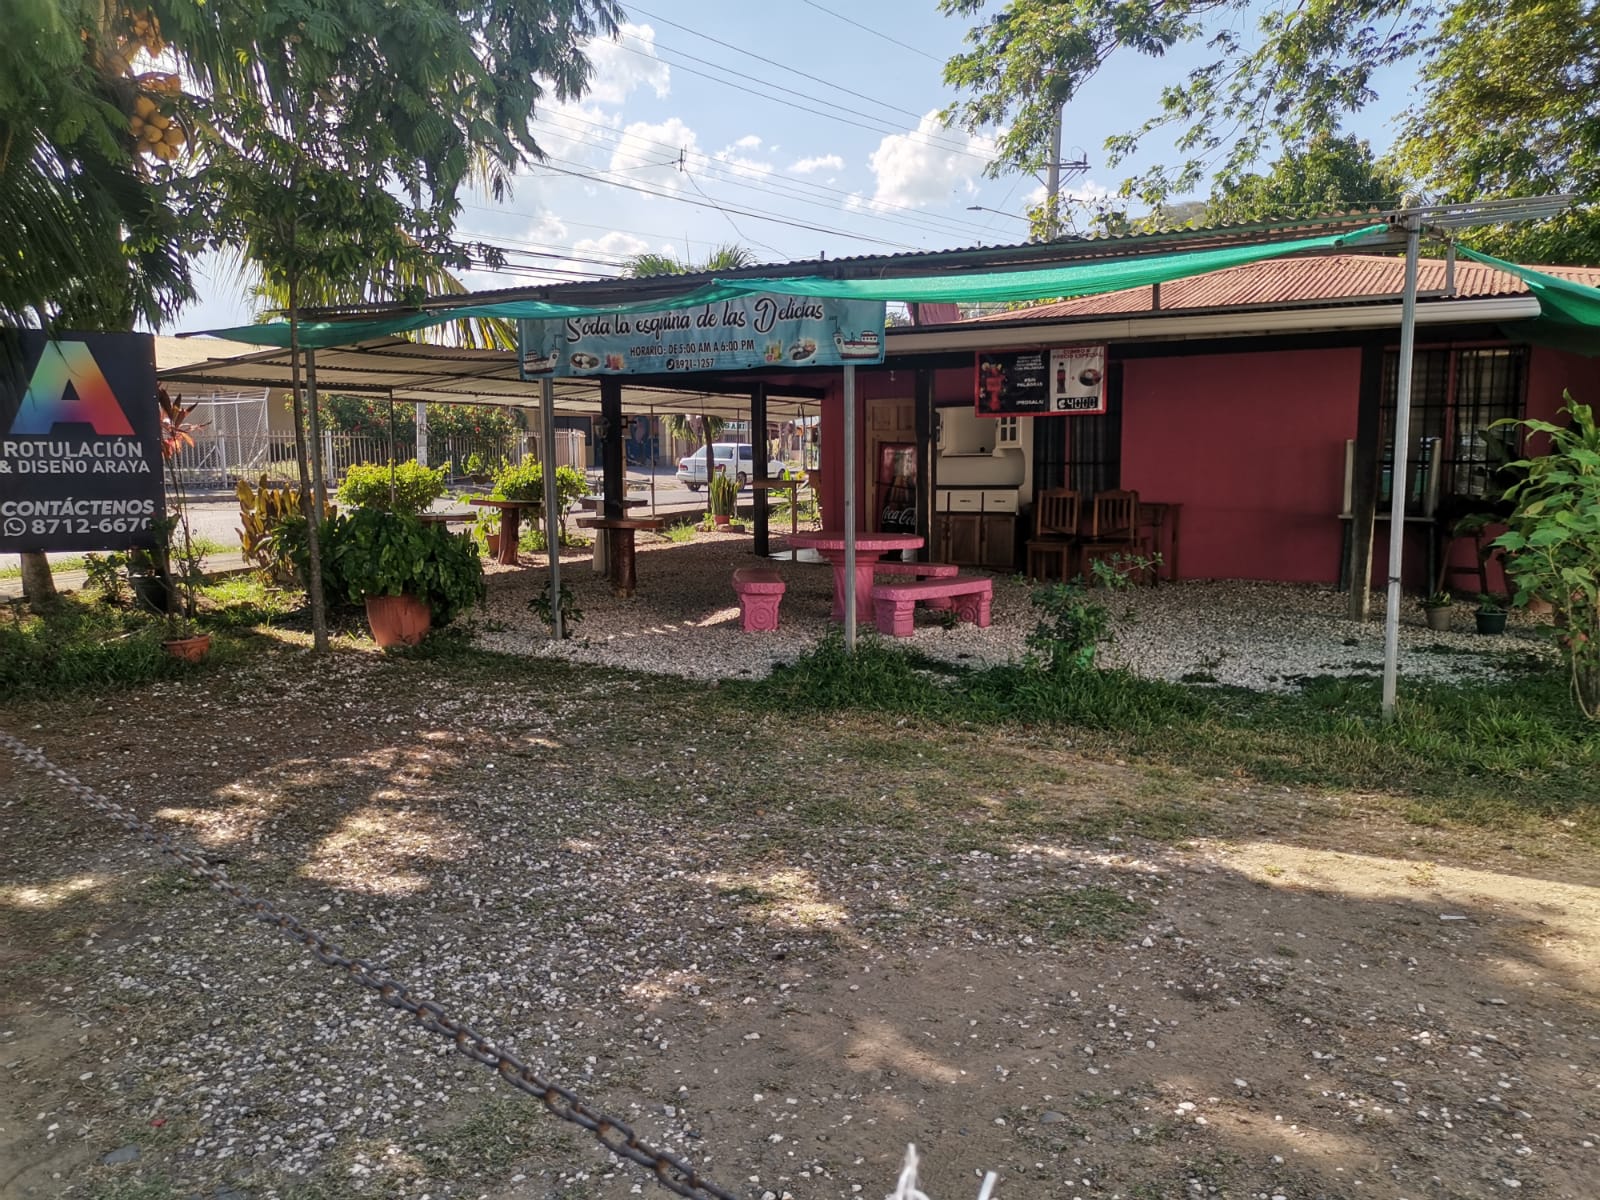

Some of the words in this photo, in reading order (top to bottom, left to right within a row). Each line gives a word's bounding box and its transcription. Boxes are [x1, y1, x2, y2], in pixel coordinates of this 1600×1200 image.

[567, 316, 609, 343] Soda
[615, 314, 630, 334] la
[636, 312, 690, 340] esquina
[697, 304, 718, 328] de
[723, 301, 746, 328] las
[754, 297, 824, 334] Delicias
[631, 346, 666, 357] HORARIO:
[669, 344, 677, 354] DE
[699, 341, 711, 352] AM
[714, 341, 719, 351] A
[721, 340, 738, 351] 6:00
[741, 339, 754, 350] PM
[9, 340, 136, 435] A
[3, 437, 143, 458] ROTULACIÓN
[18, 457, 87, 474] DISEÑO
[92, 460, 151, 474] ARAYA
[1, 496, 155, 517] CONTÁCTENOS
